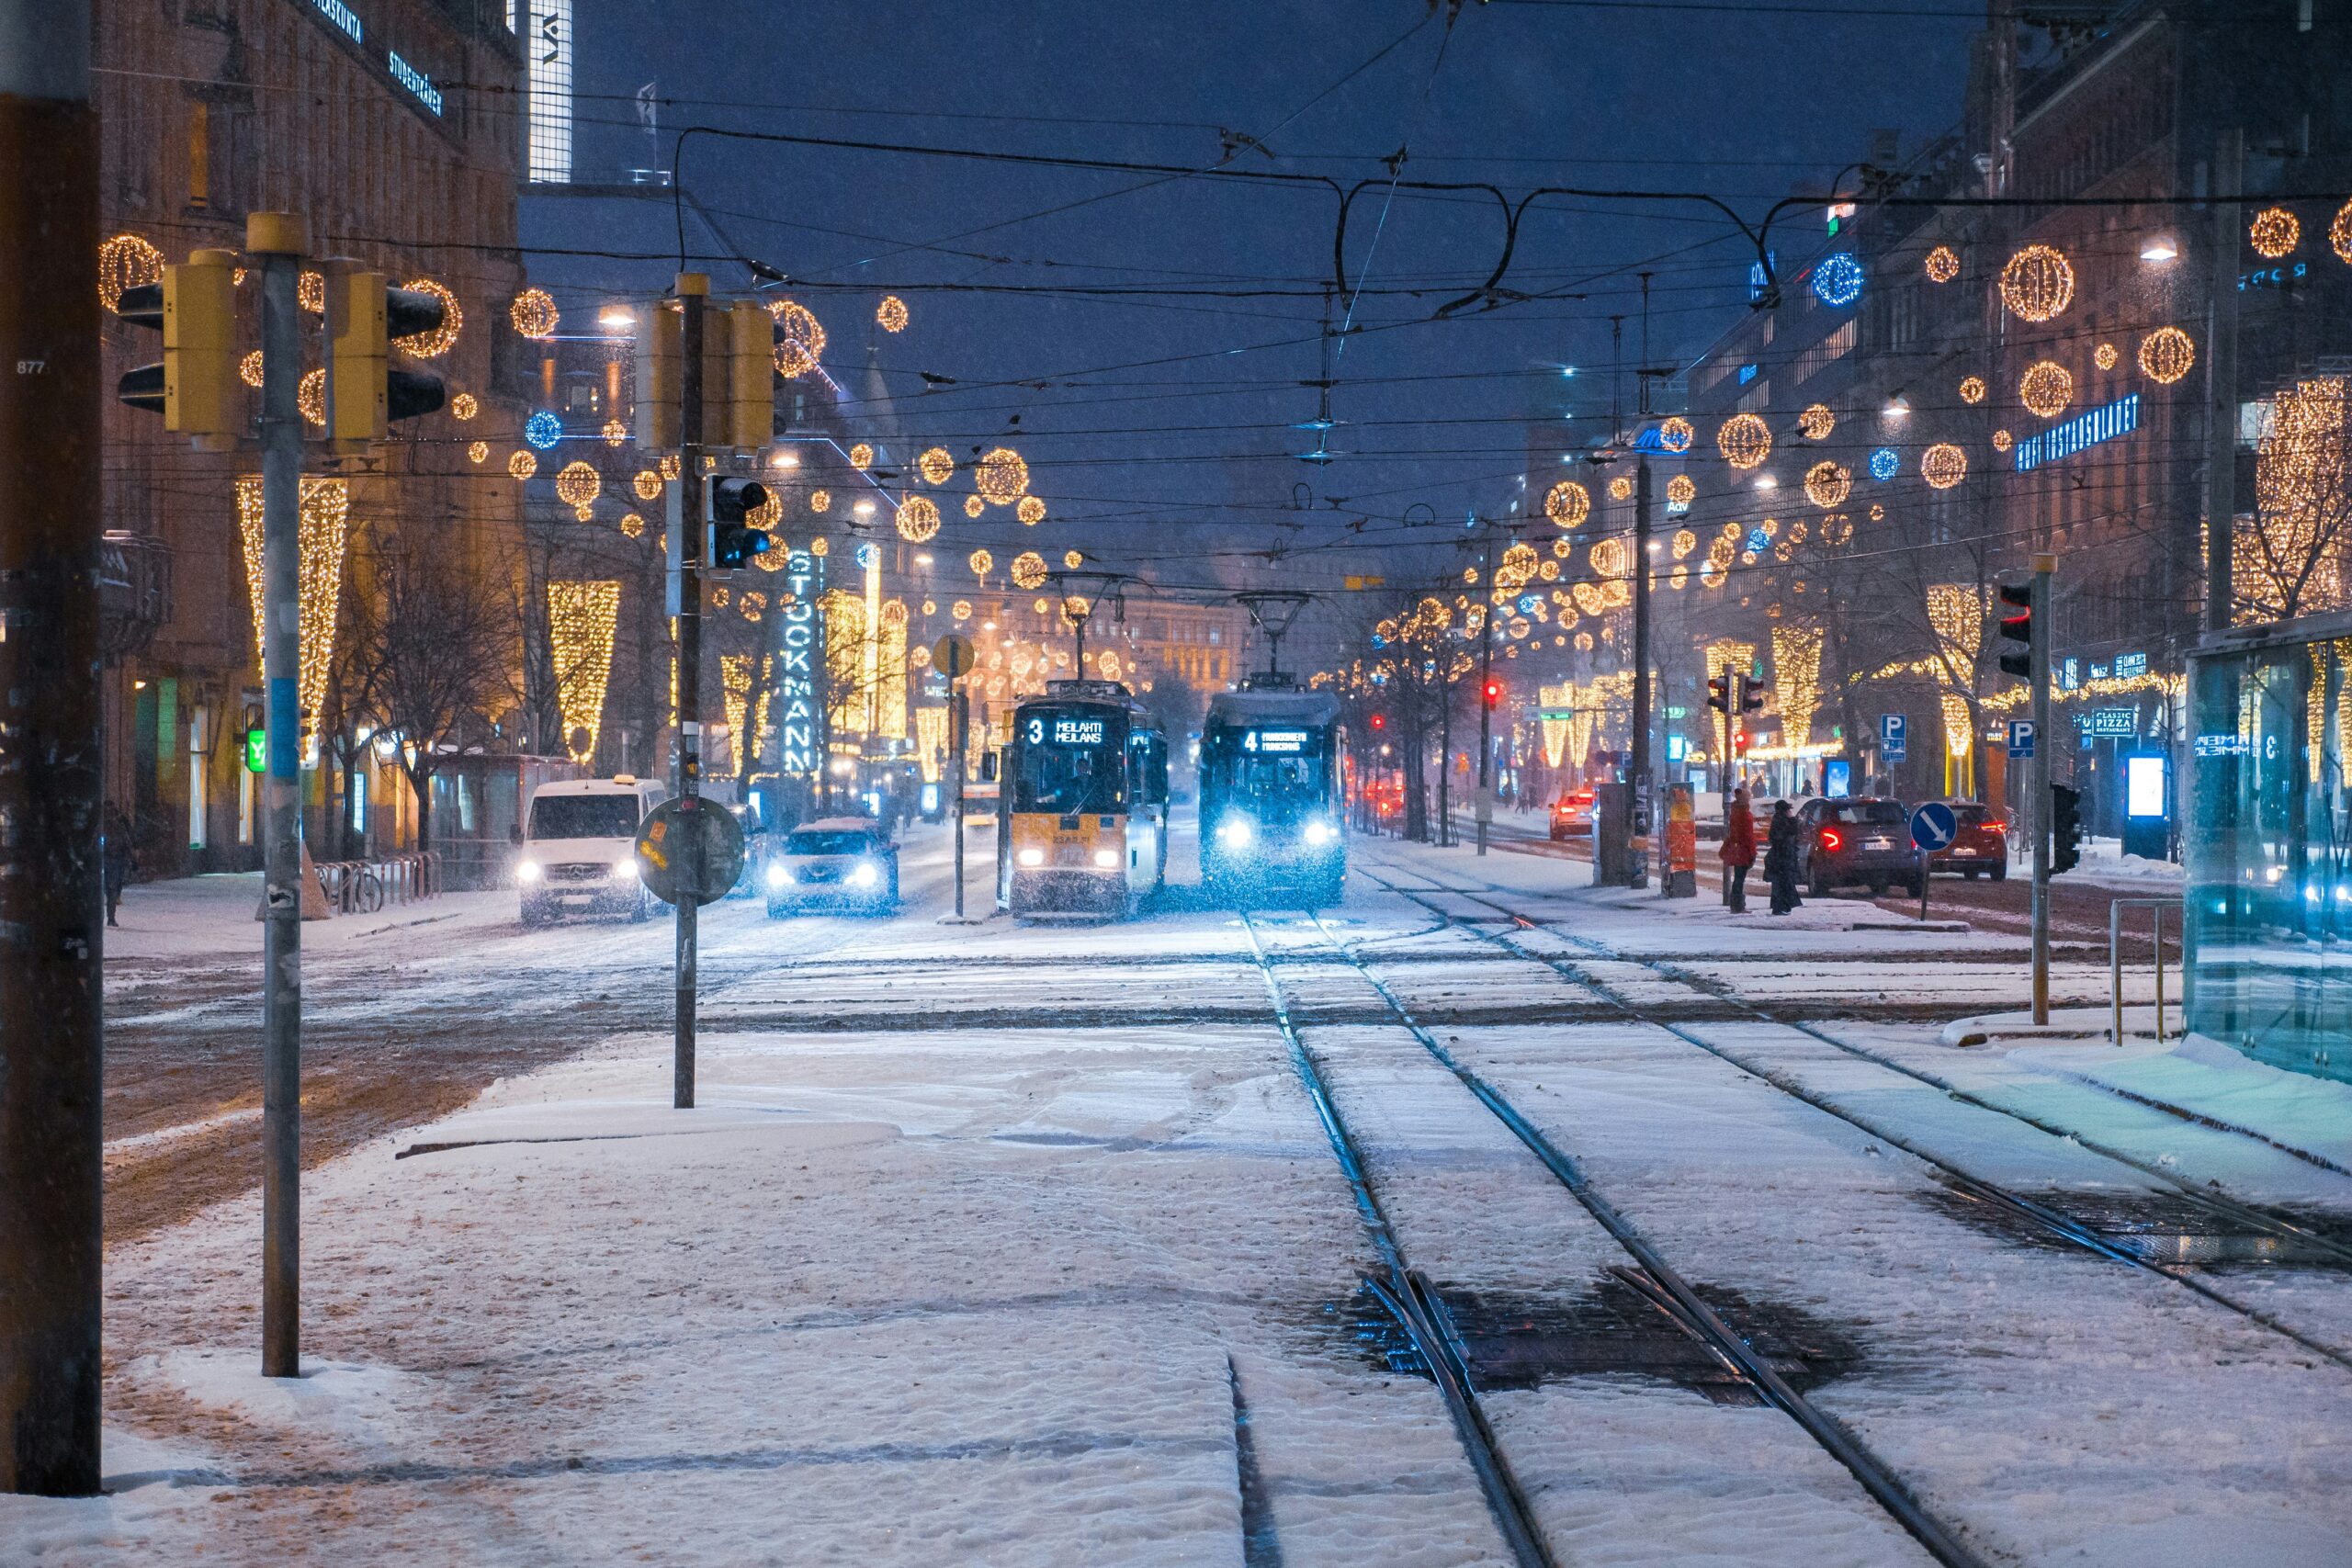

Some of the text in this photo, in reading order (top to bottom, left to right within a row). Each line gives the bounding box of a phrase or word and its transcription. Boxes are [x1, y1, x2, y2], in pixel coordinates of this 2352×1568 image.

[313, 0, 361, 44] LASKUNTA
[390, 51, 441, 117] STUDENTKÅREN
[17, 361, 44, 374] 877
[786, 550, 811, 771] STOCKMANN
[1029, 719, 1043, 744] 3
[1886, 716, 1902, 738] P
[2015, 723, 2033, 747] P
[1245, 732, 1258, 751] 4
